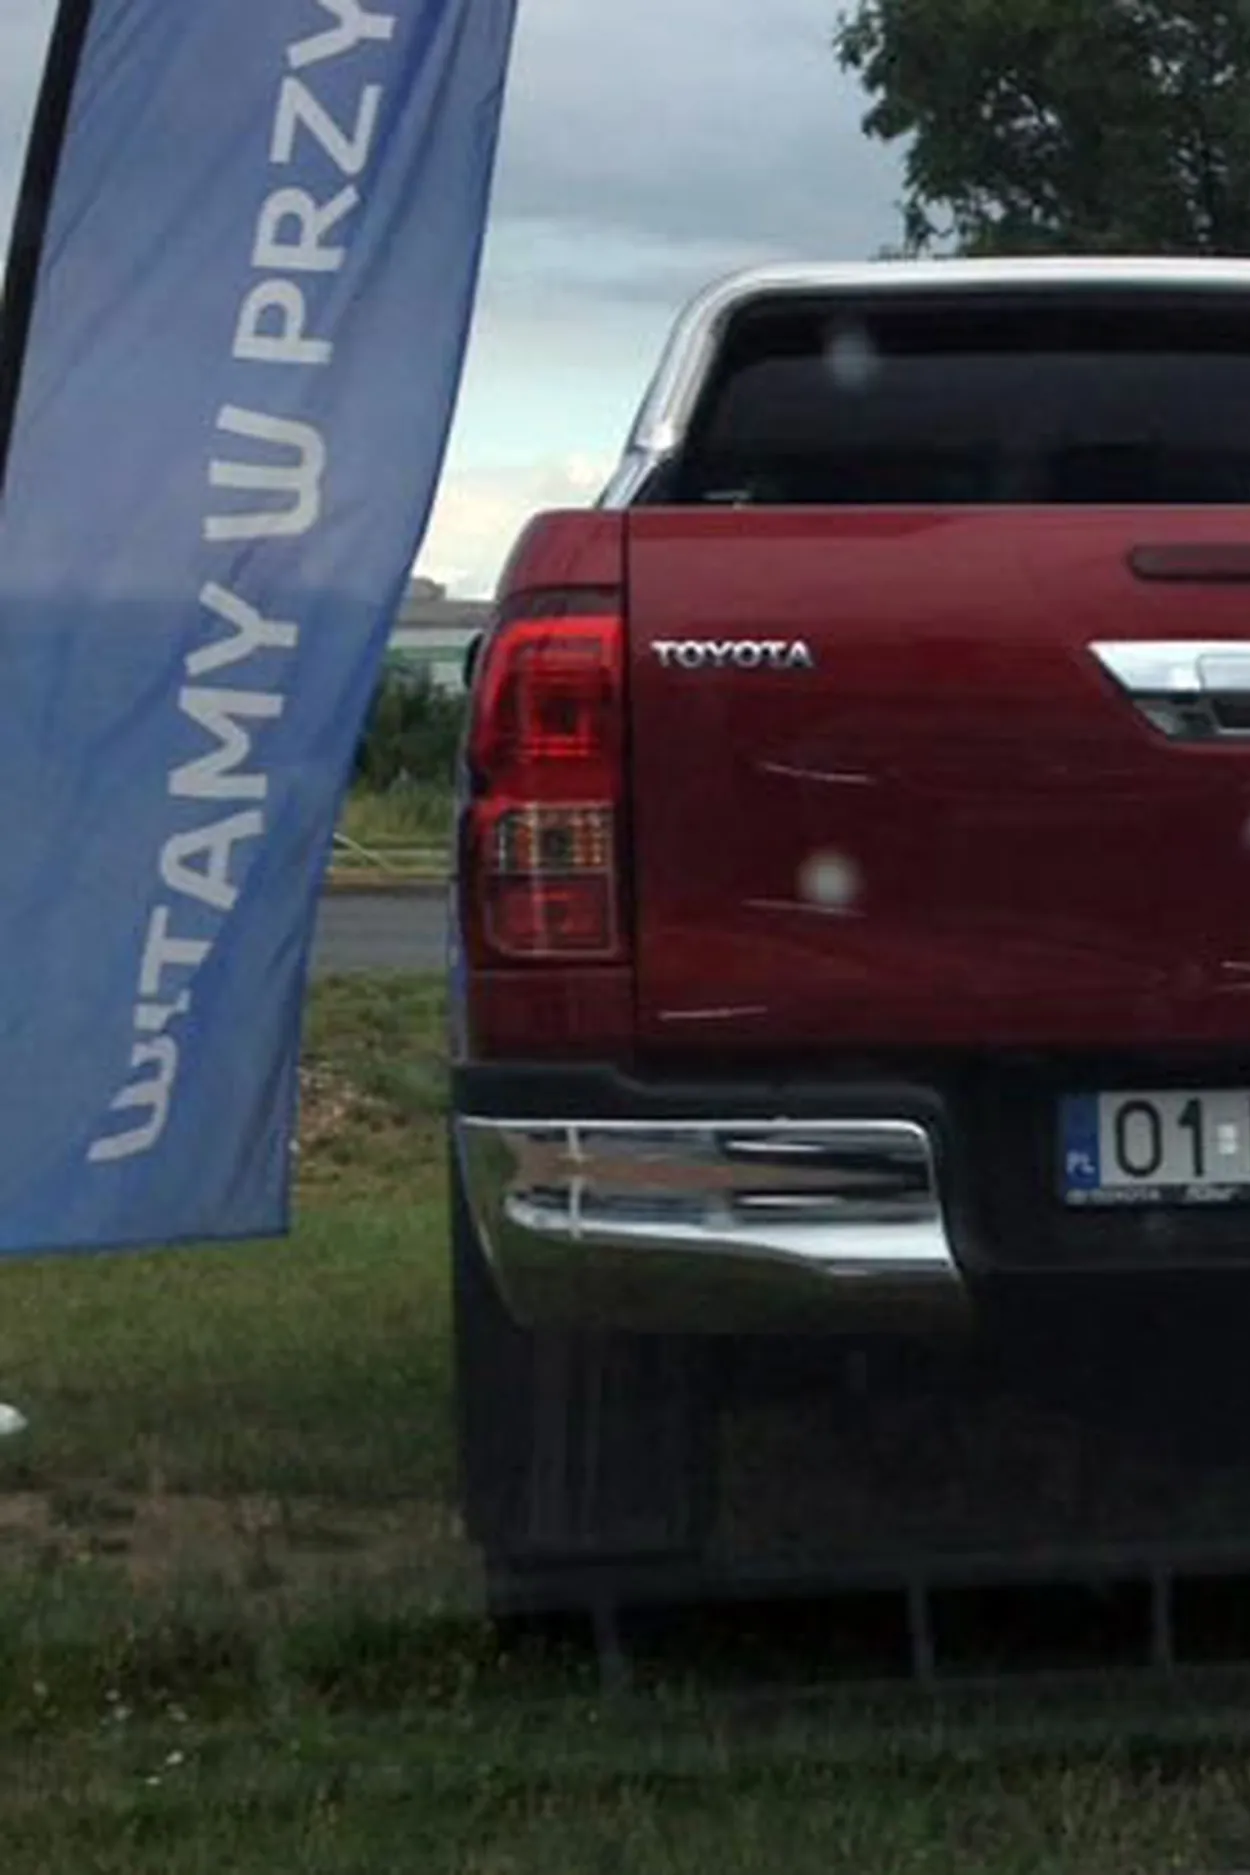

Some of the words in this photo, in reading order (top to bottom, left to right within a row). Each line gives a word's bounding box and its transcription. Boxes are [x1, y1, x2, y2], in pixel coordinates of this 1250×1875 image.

[87, 582, 298, 1162] WITAMY
[202, 403, 327, 541] W
[650, 639, 814, 669] TOYOTA
